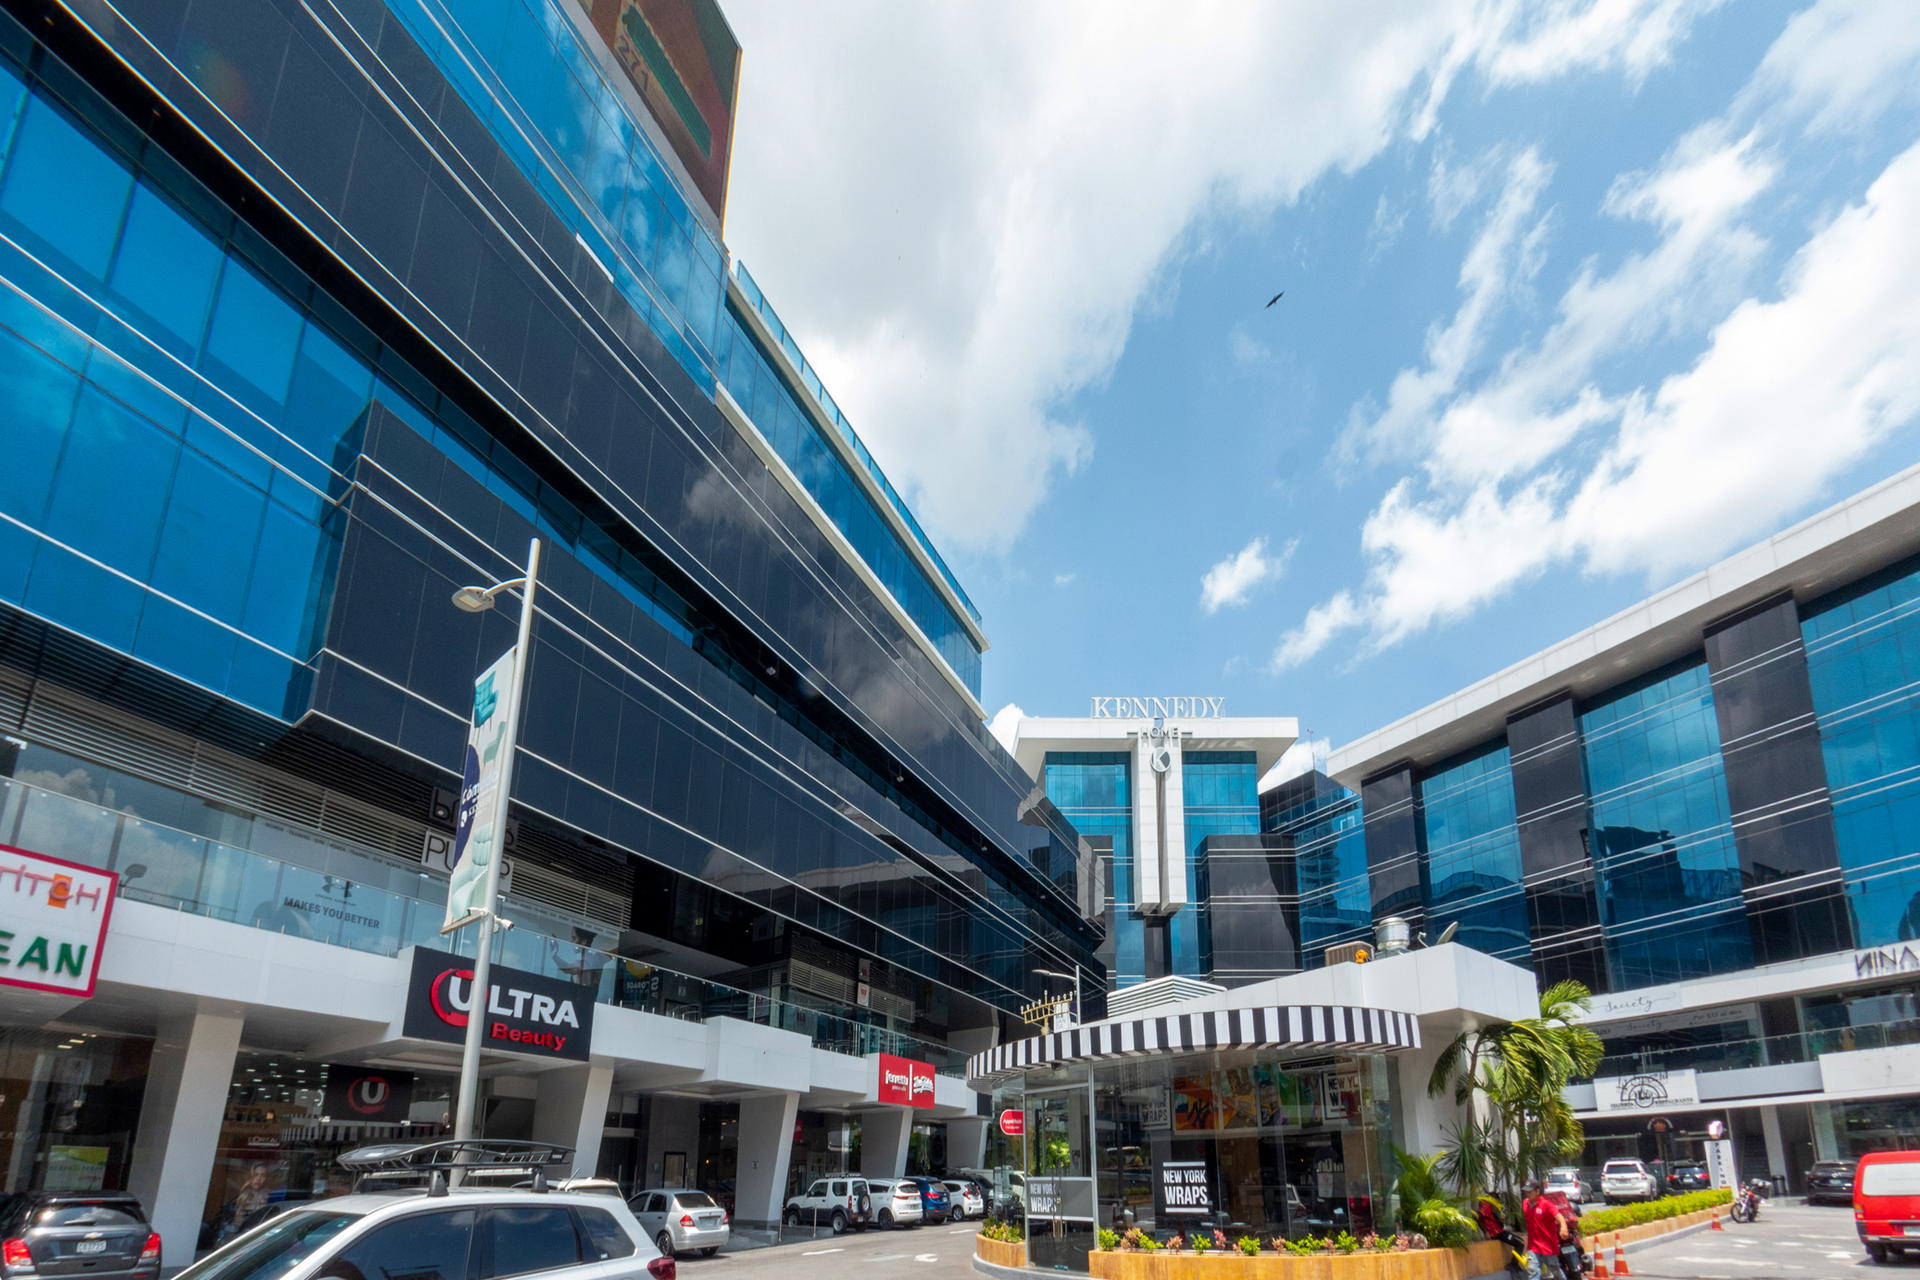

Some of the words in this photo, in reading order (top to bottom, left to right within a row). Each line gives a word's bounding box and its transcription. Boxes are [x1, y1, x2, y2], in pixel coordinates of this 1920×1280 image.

[1090, 696, 1226, 719] KENNEDY
[1140, 727, 1180, 740] HOME
[284, 896, 321, 914] MAKES
[323, 906, 344, 920] YOU
[344, 912, 380, 929] BETTER
[448, 976, 580, 1029] ULTRA
[491, 1022, 567, 1052] Beauty
[361, 1081, 385, 1104] U
[1163, 1169, 1182, 1184] NEW
[1183, 1169, 1207, 1184] YORK
[1030, 1183, 1042, 1195] NEW
[1164, 1186, 1208, 1205] WRAPS
[1031, 1197, 1057, 1213] WRAPS
